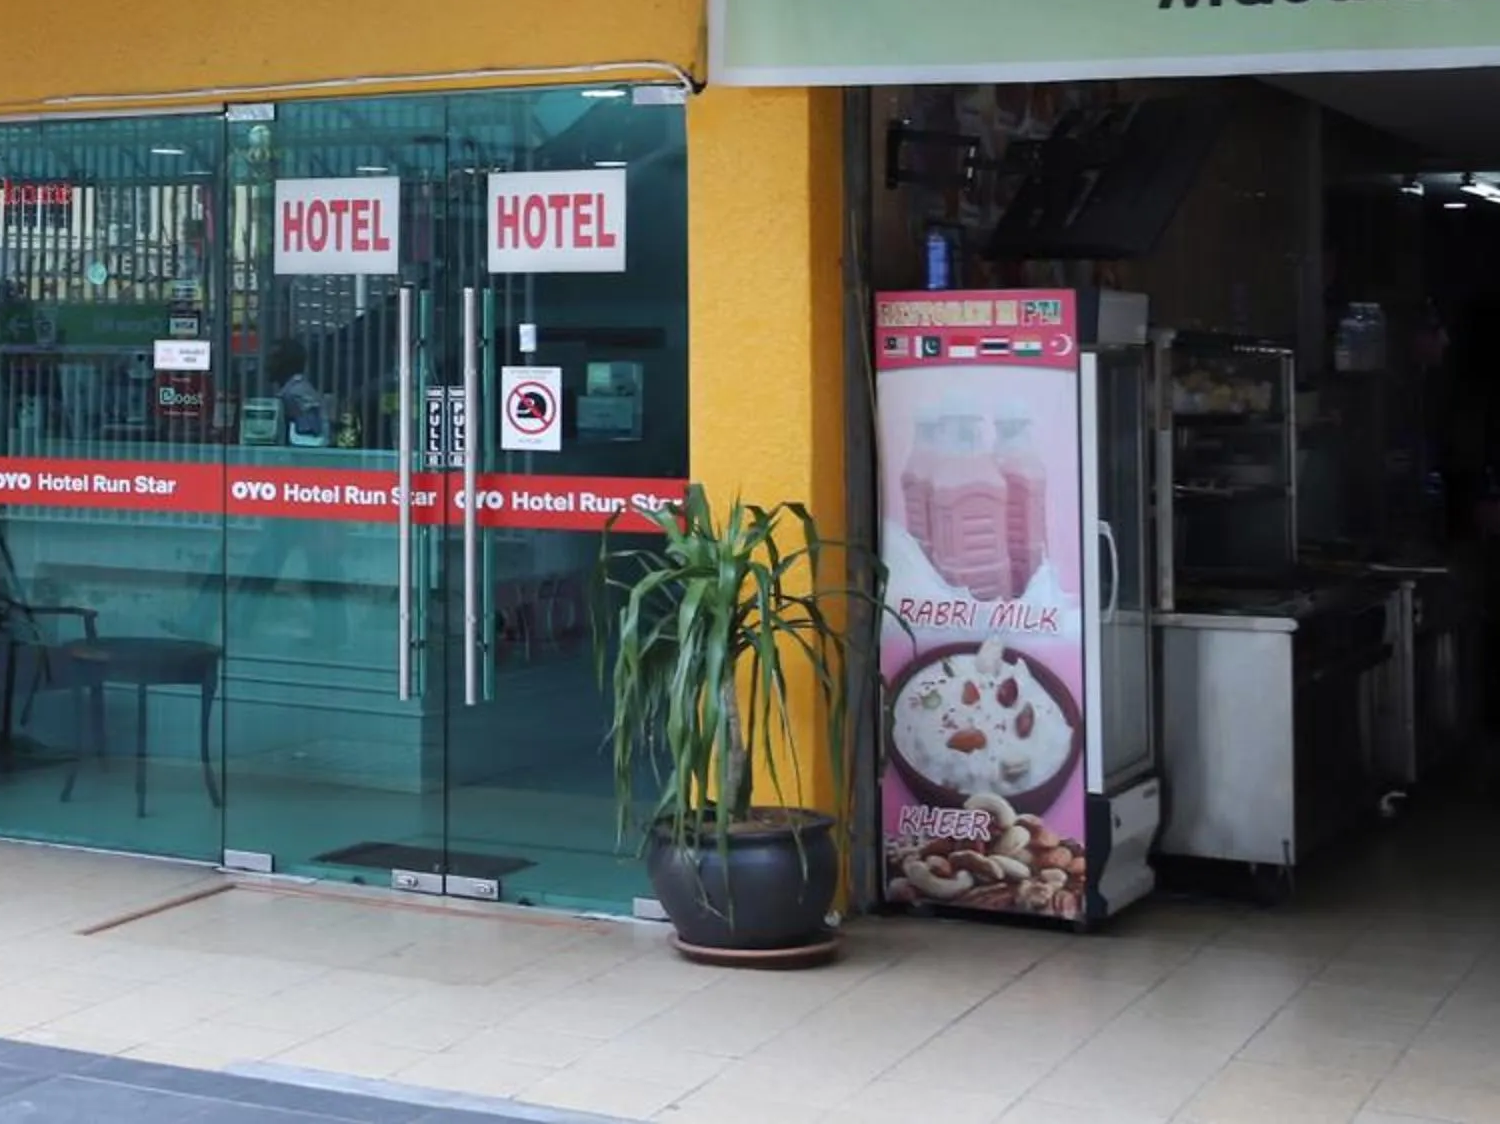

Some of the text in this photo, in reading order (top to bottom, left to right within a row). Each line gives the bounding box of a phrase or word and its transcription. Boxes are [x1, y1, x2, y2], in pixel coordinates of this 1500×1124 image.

[283, 199, 390, 253] HOTEL
[497, 192, 616, 250] HOTEL
[429, 401, 441, 451] PULL
[453, 401, 465, 451] PULL
[38, 473, 89, 492] Hotel
[93, 475, 131, 493] Run
[134, 476, 177, 495] Star
[231, 481, 276, 500] OYO
[284, 483, 339, 504] Hotel
[344, 485, 386, 505] Run
[511, 490, 575, 512] Hotel
[579, 492, 627, 513] Run
[900, 598, 1058, 632] RABRI MILK
[900, 805, 991, 842] KHEER
